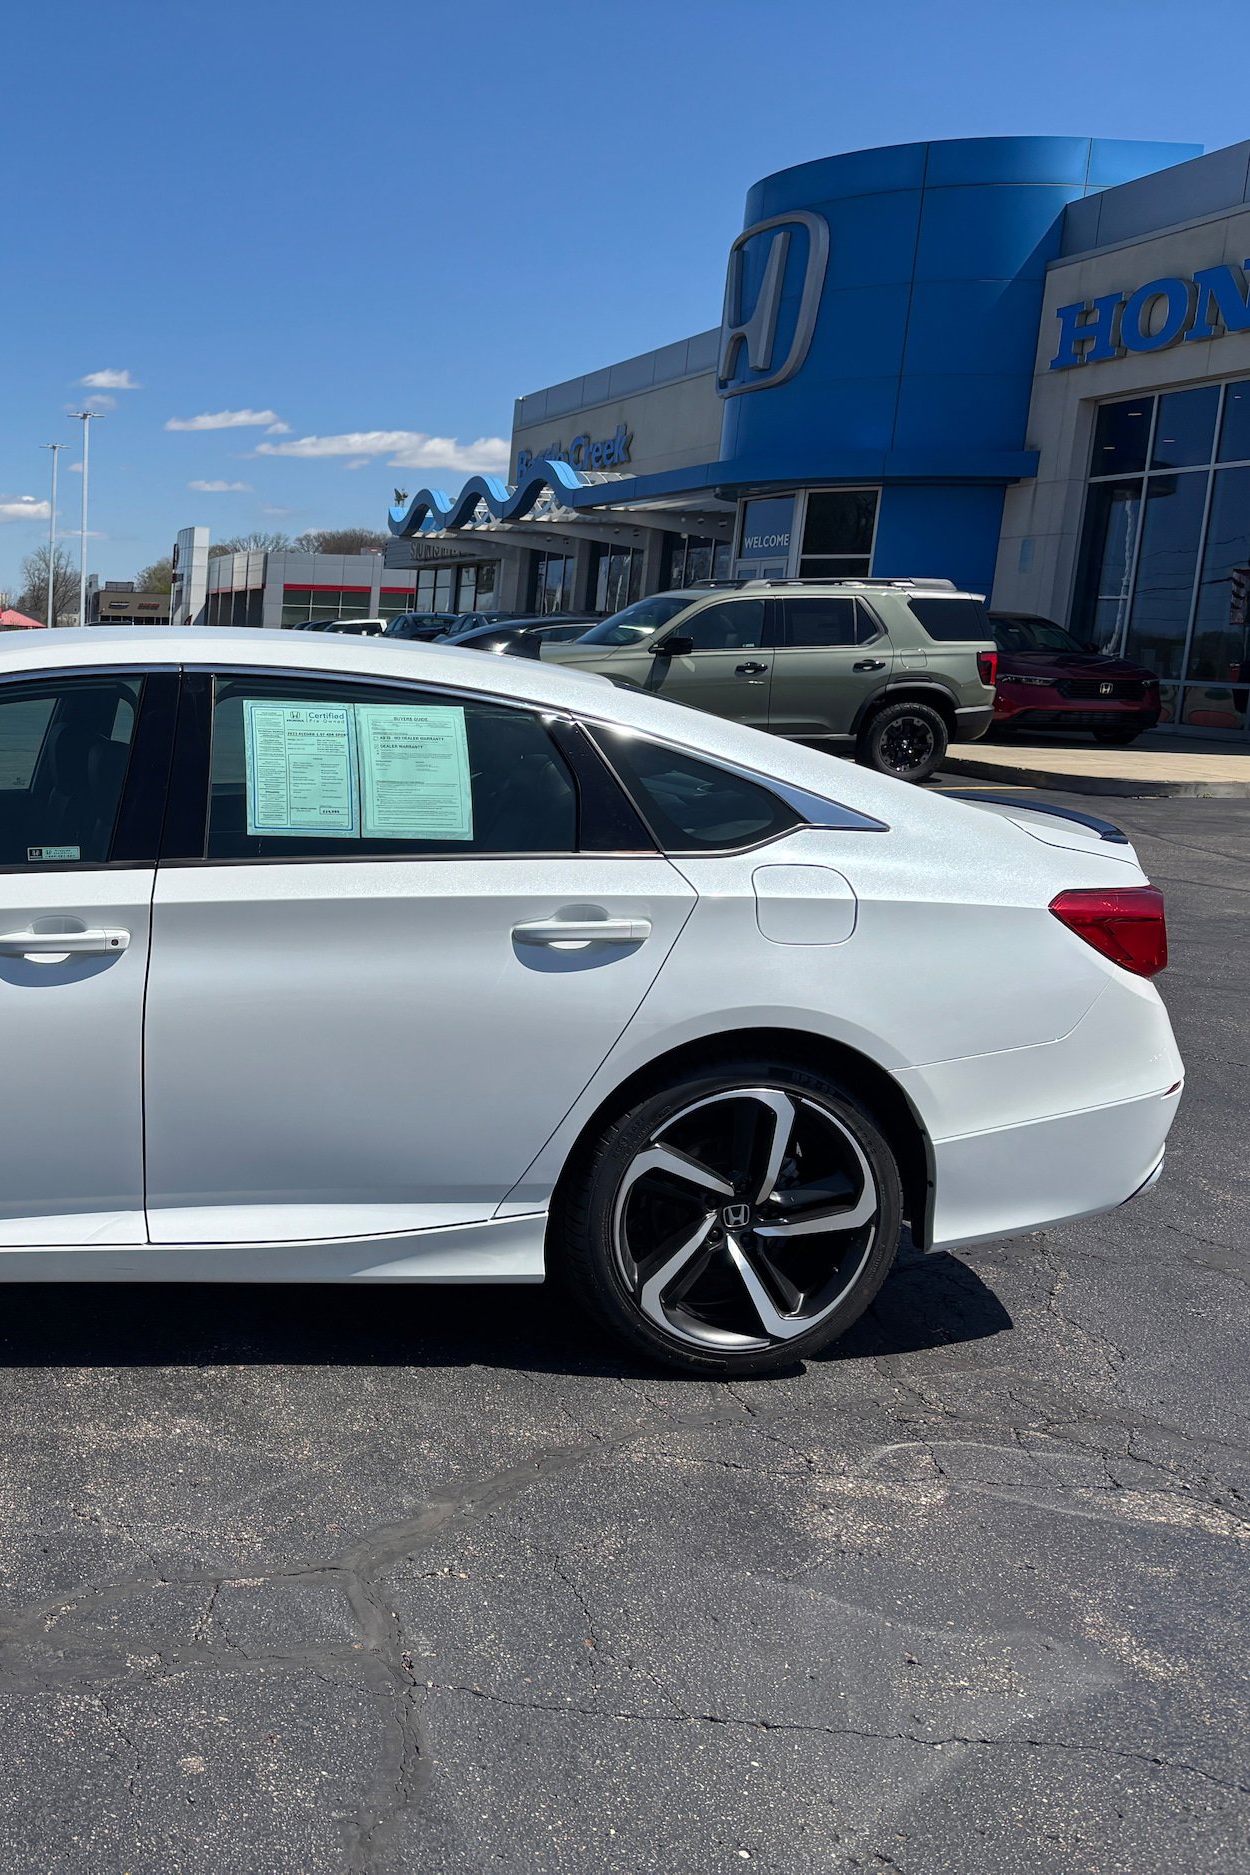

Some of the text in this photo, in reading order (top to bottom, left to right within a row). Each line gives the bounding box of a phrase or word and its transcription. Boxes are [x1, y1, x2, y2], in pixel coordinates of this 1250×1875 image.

[569, 424, 630, 471] Creek
[744, 533, 790, 549] WELCOME
[308, 712, 344, 720] Certified
